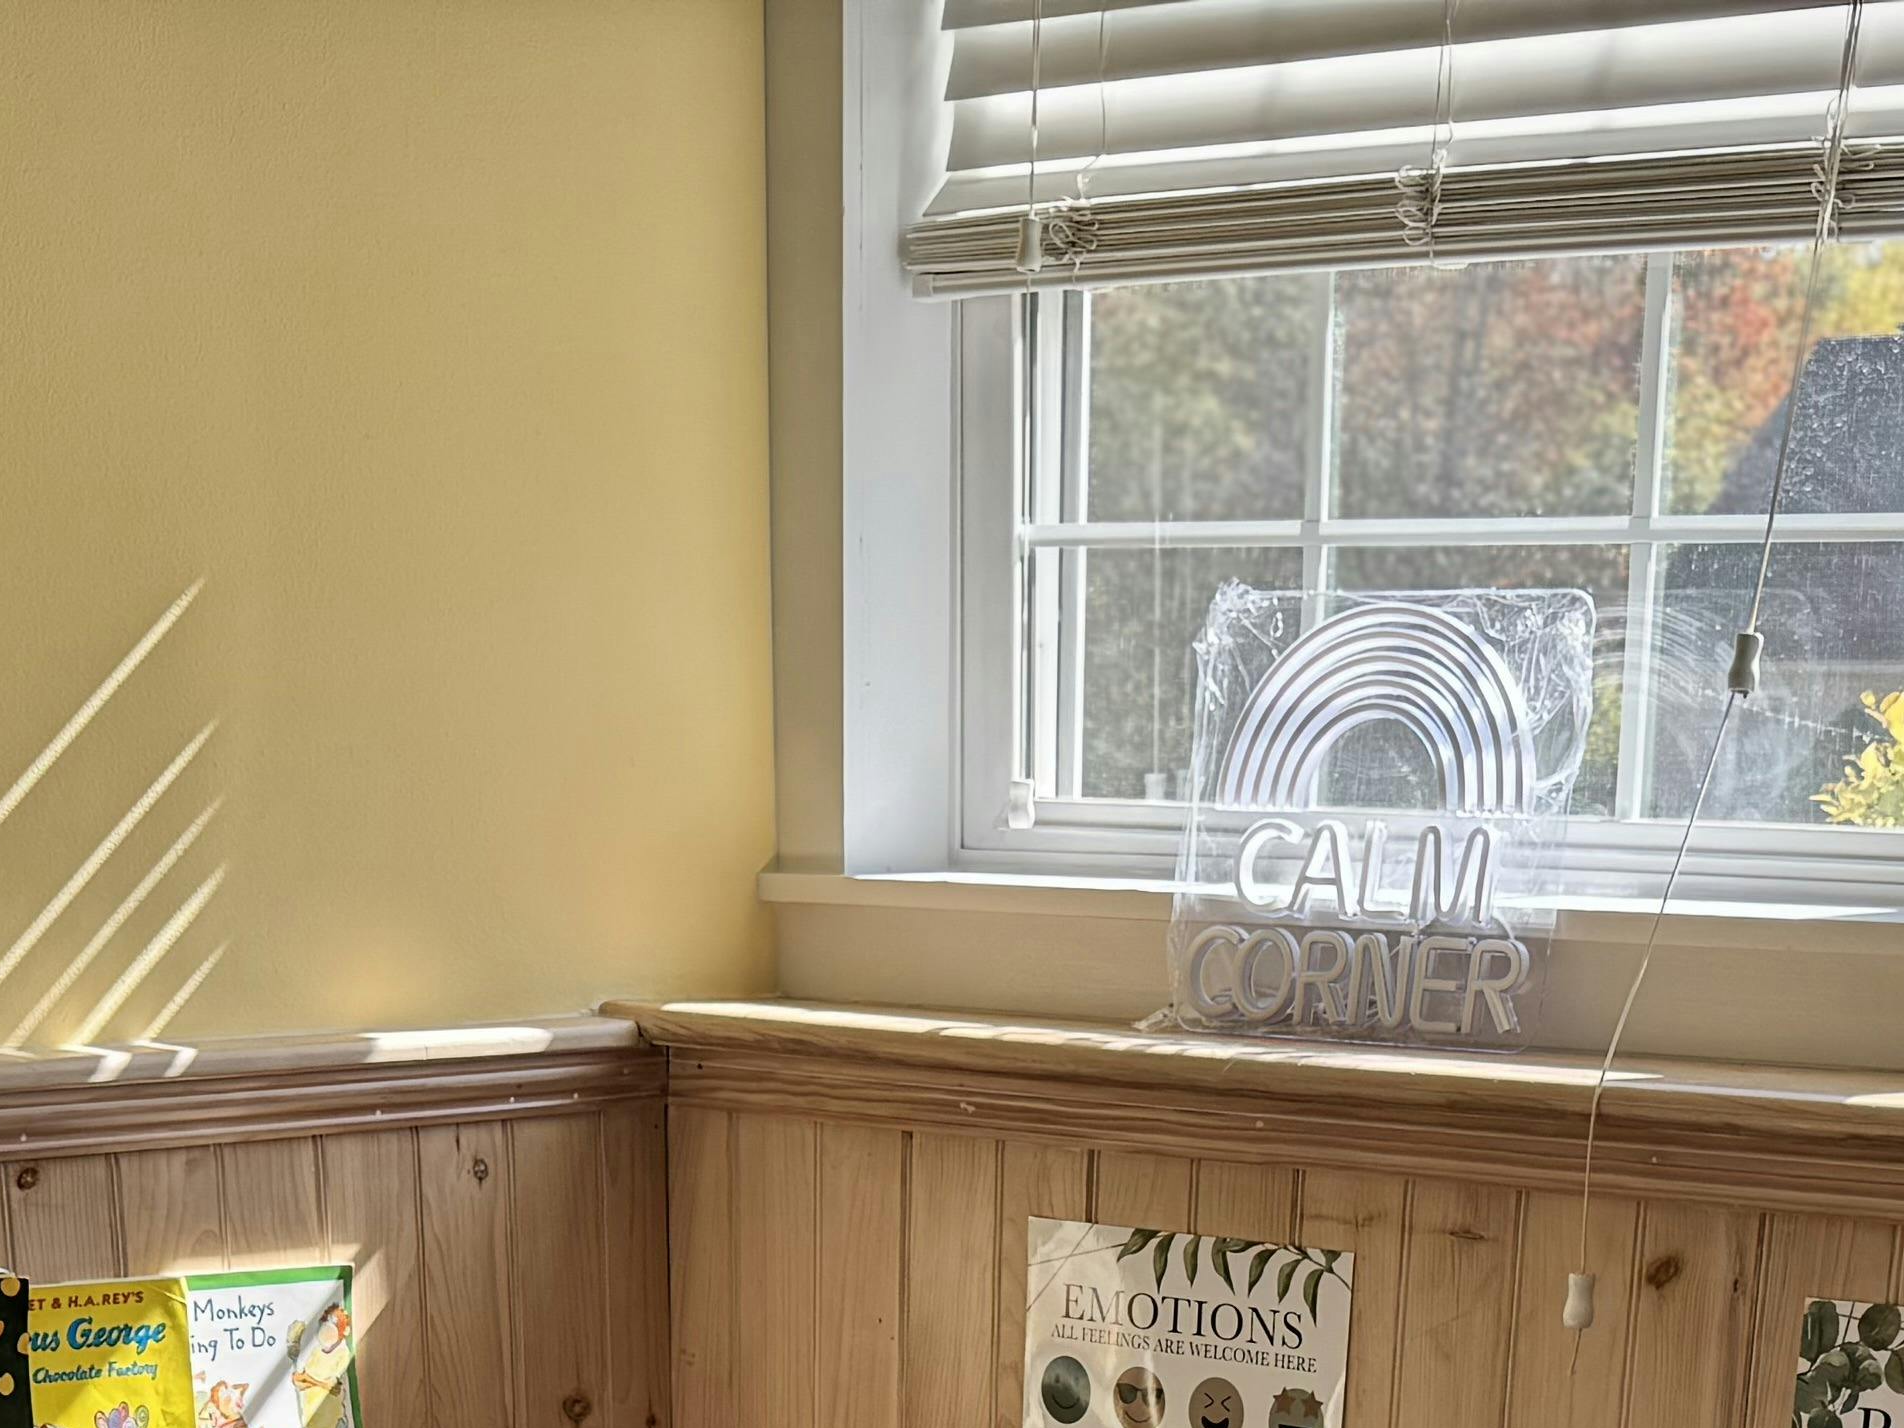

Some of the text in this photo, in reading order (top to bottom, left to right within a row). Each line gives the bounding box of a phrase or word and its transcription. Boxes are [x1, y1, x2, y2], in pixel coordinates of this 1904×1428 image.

[1235, 818, 1492, 928] CALM
[1186, 926, 1530, 1034] CORNER
[51, 1297, 62, 1310] &
[194, 1295, 274, 1325] Monkeys
[1061, 1283, 1303, 1350] EMOTIONS
[66, 1316, 167, 1355] George
[223, 1328, 245, 1351] To
[251, 1326, 276, 1348] Do
[32, 1361, 159, 1385] Chocolate Factory
